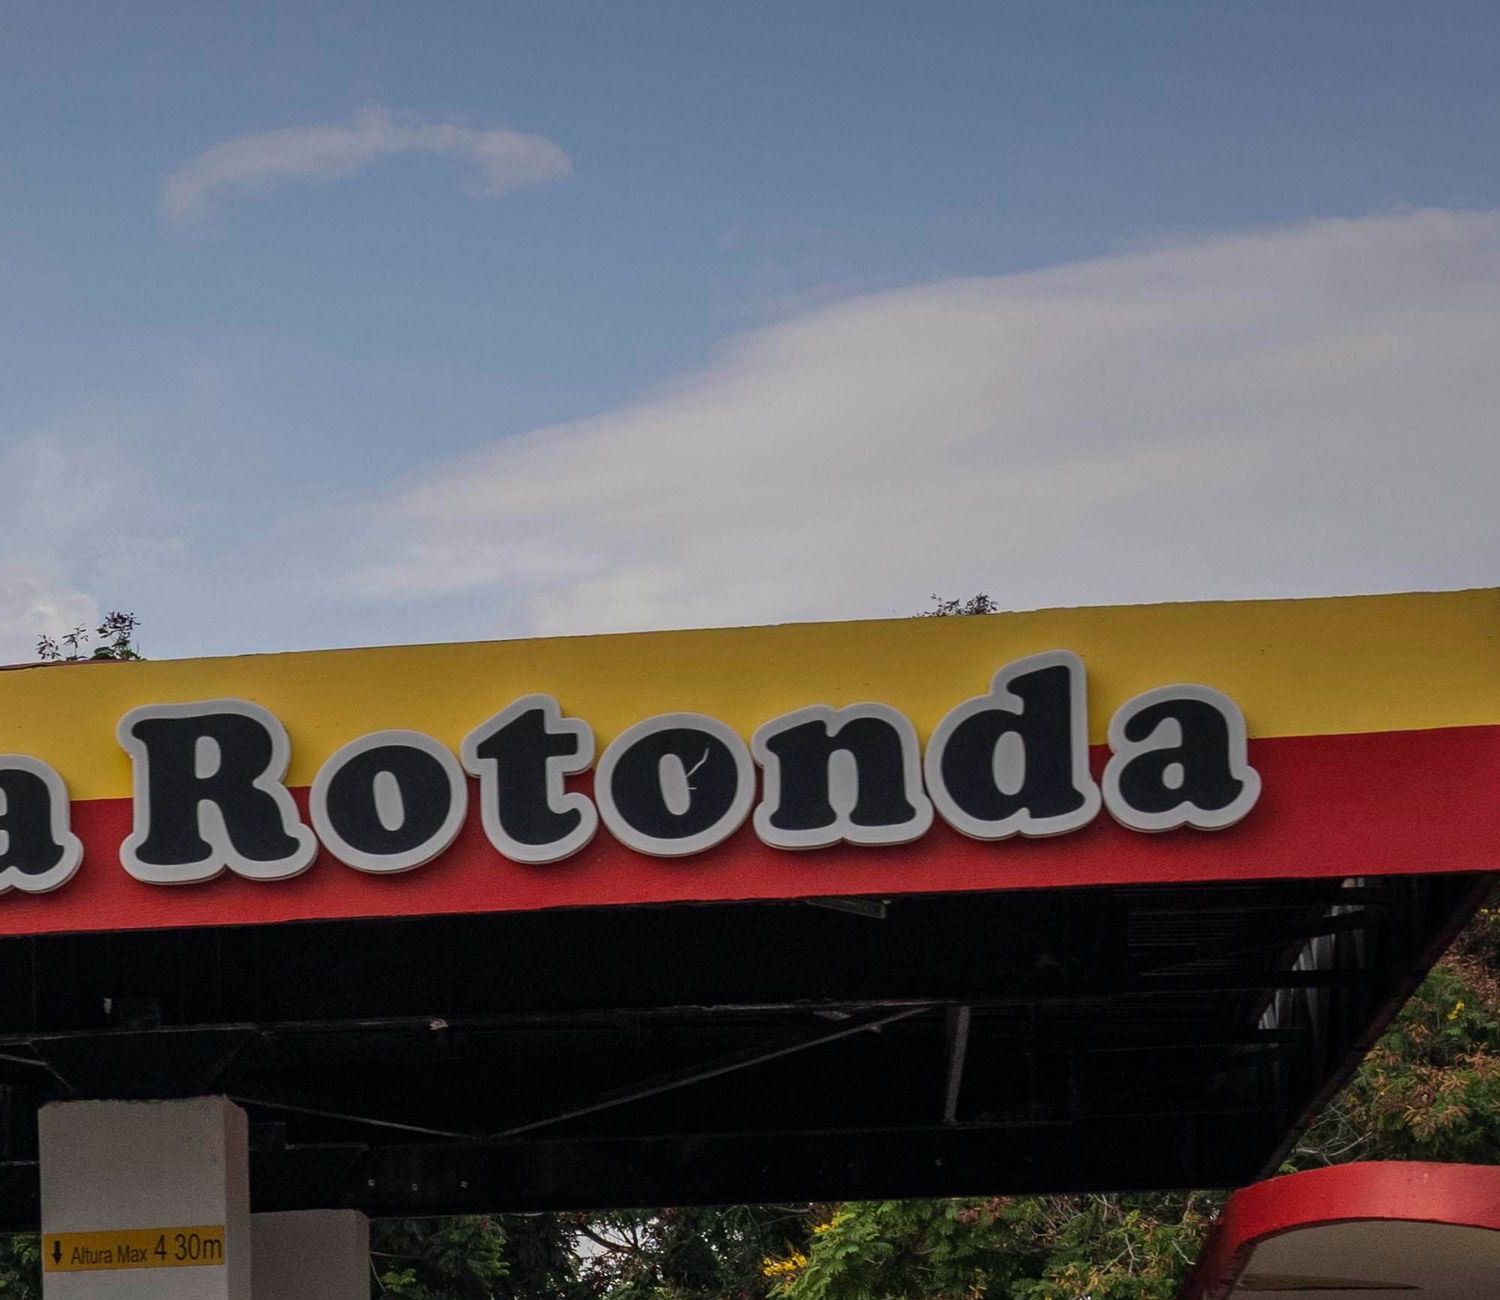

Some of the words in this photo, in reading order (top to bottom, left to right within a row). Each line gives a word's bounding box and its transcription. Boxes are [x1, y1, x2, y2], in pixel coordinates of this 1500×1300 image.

[117, 649, 1262, 885] Rotonda
[71, 1246, 113, 1265] Altura
[117, 1245, 148, 1263] Max
